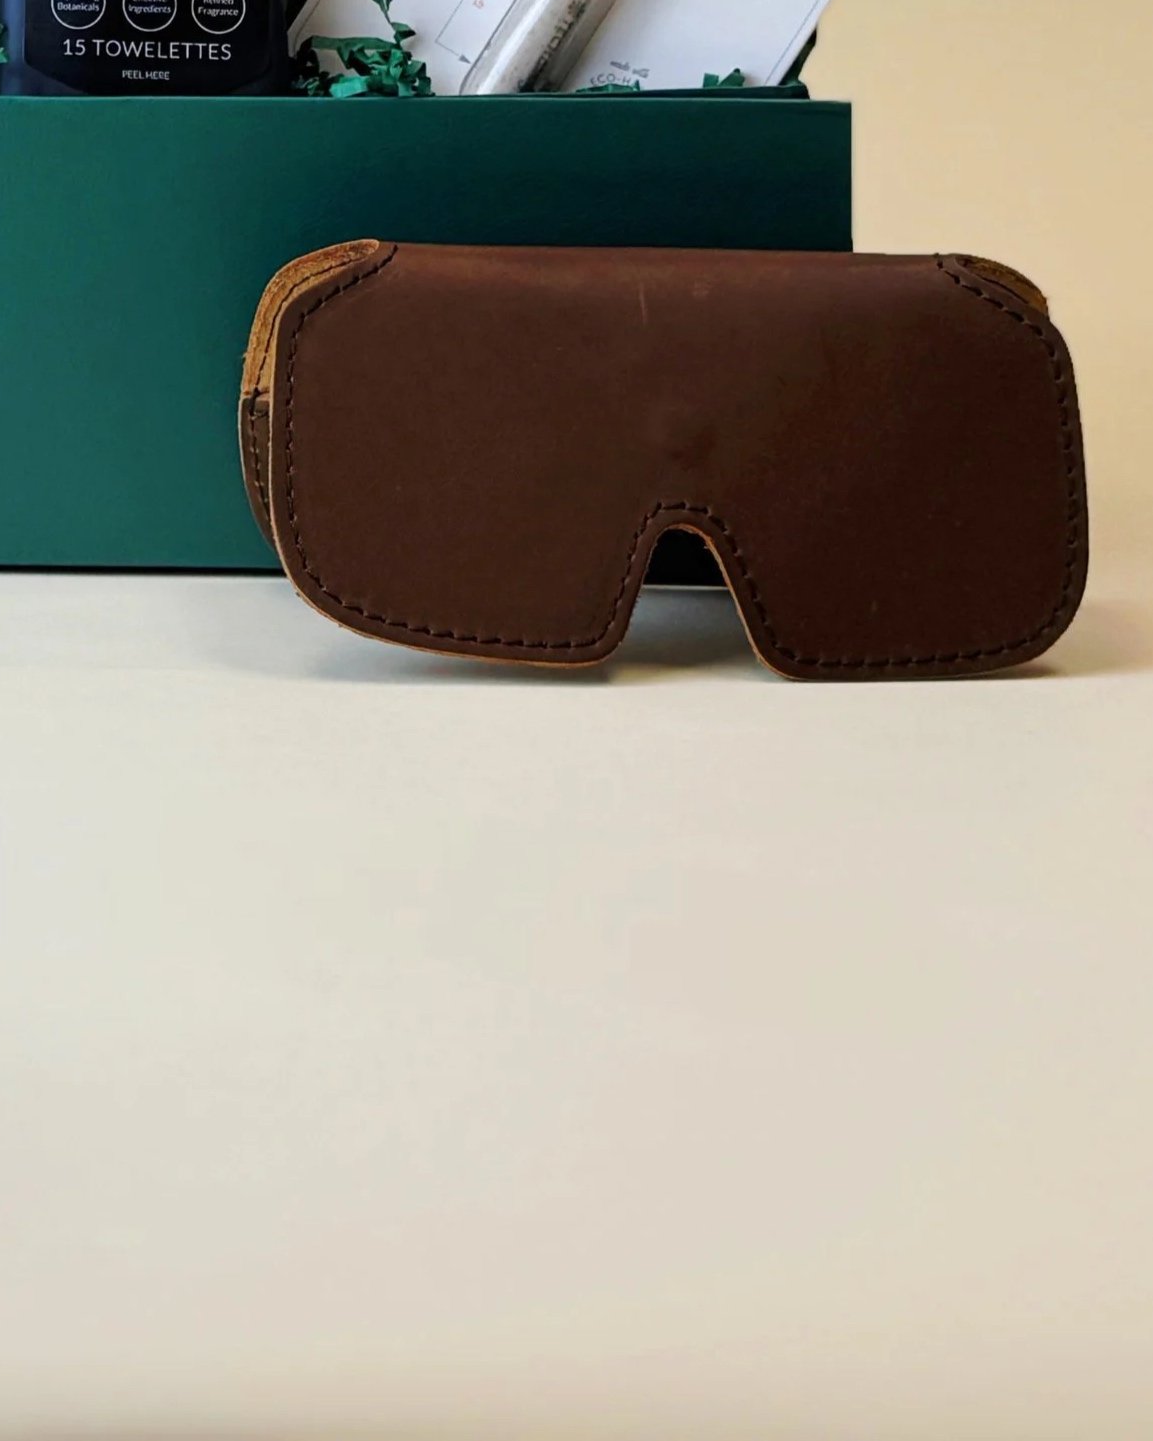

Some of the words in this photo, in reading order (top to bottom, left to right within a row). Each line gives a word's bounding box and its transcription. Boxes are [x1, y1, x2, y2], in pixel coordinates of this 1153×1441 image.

[57, 1, 100, 12] Botanicals
[128, 4, 171, 14] Ingredients
[198, 6, 239, 17] Fragrance
[63, 39, 87, 56] 15
[92, 39, 232, 60] TOWELETTES
[122, 70, 145, 79] PEEL
[146, 71, 170, 80] HERE
